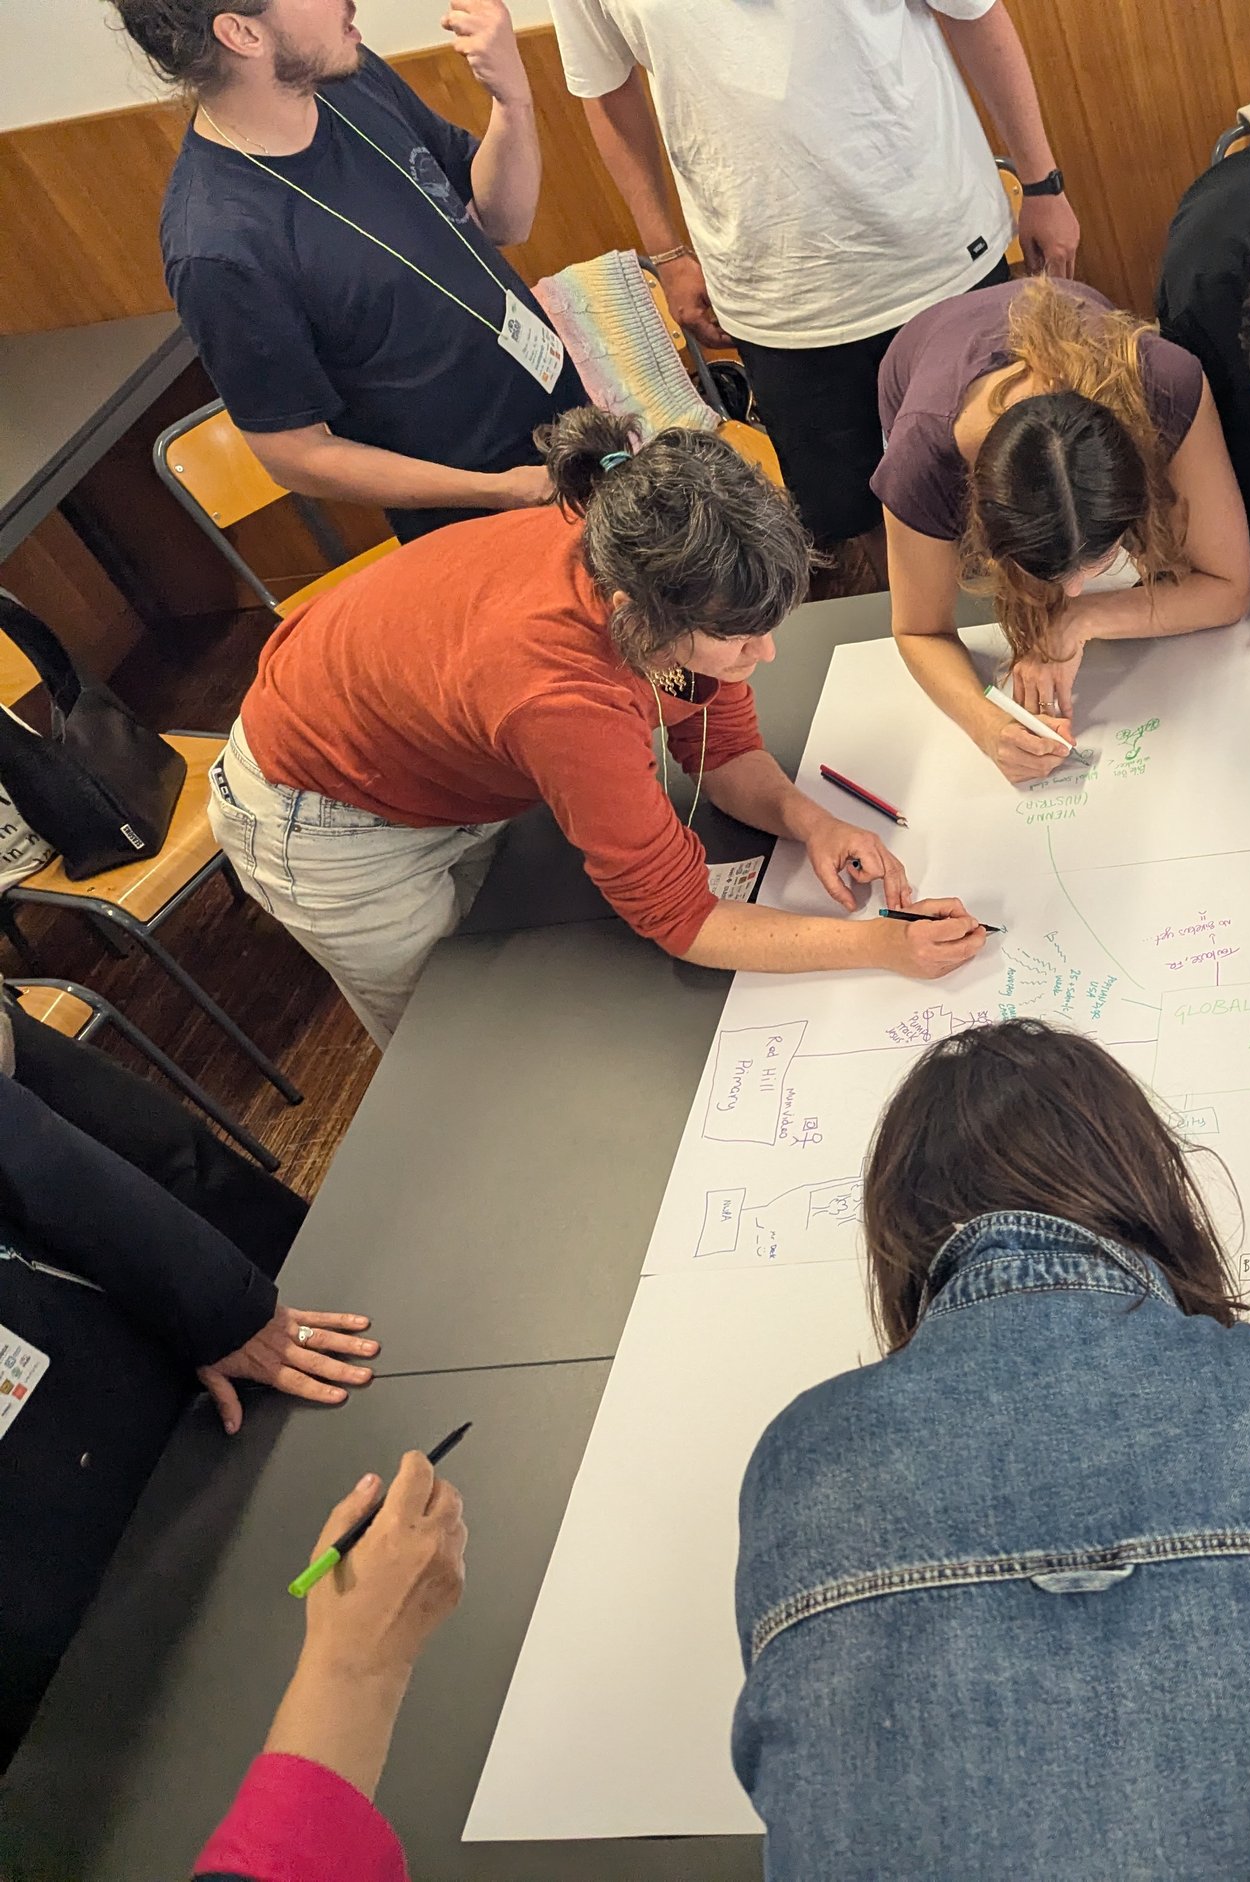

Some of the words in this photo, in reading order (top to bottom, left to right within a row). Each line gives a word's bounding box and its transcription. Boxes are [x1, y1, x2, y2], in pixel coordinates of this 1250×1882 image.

[1026, 809, 1076, 824] VIENNA
[1086, 981, 1099, 998] USA
[716, 1059, 754, 1112] Primary
[760, 1067, 777, 1092] Hill
